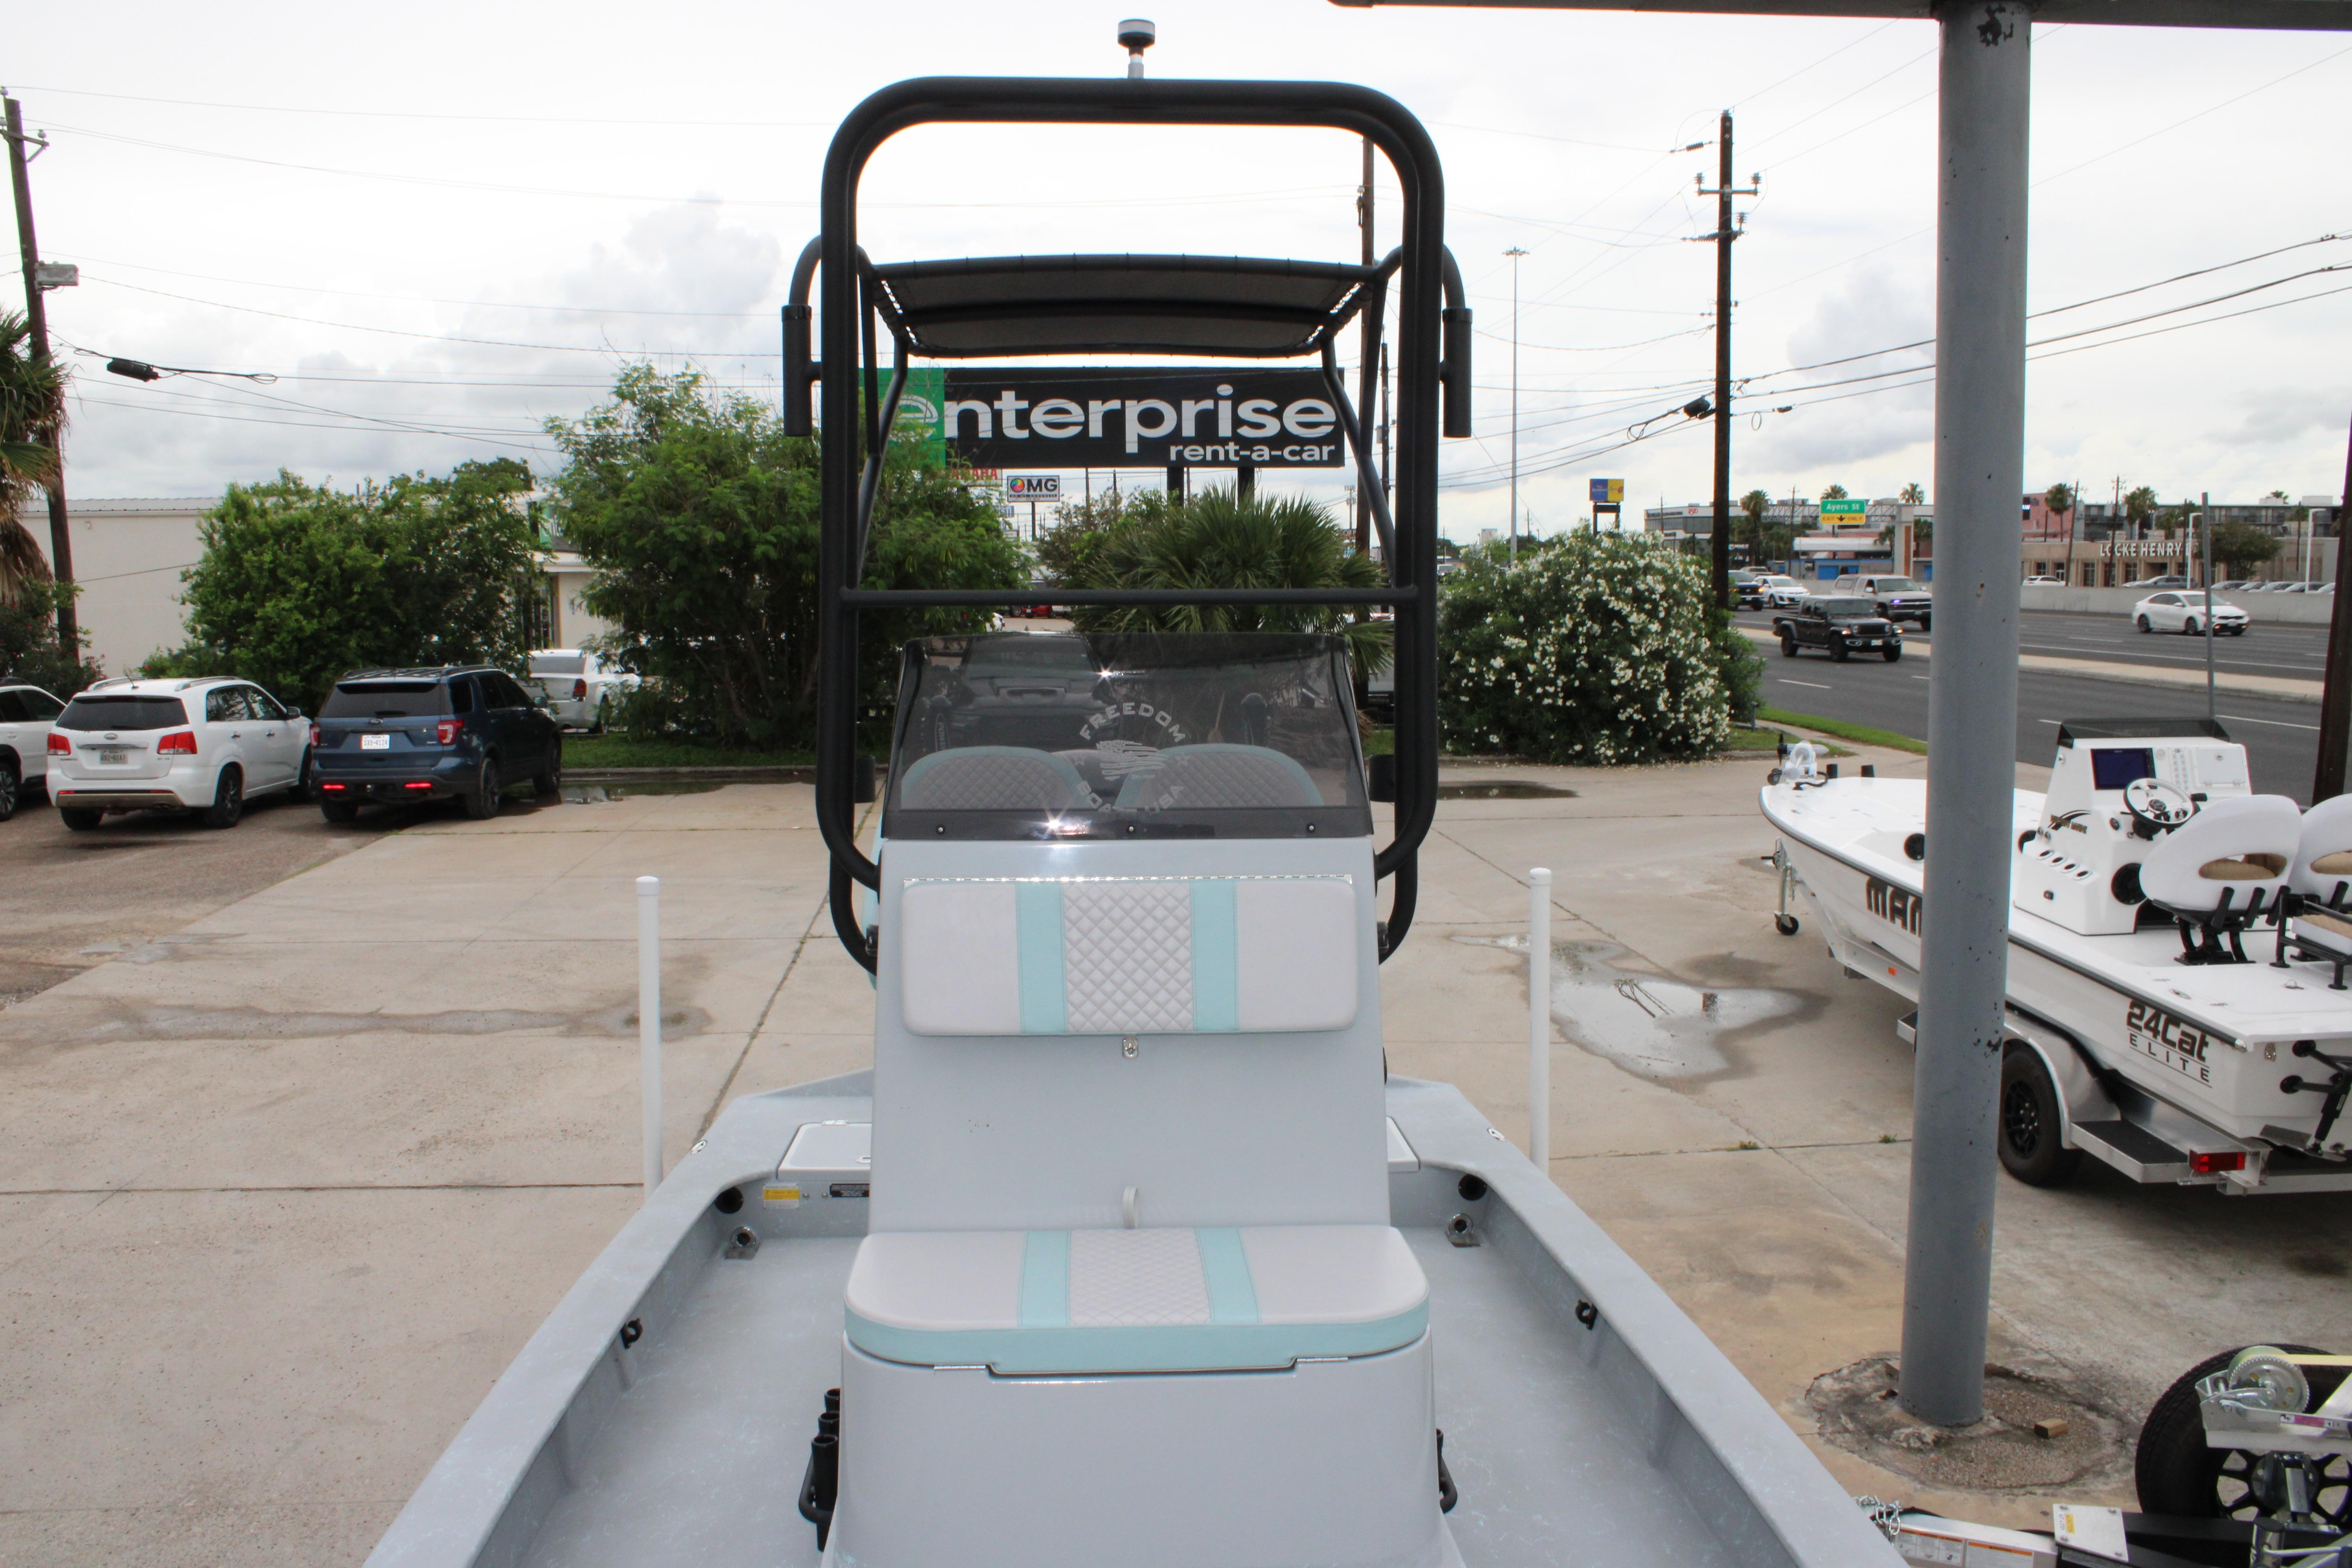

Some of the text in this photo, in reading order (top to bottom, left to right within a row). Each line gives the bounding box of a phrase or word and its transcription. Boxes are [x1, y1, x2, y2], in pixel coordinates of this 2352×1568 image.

[1170, 441, 1335, 461] rent-a-car
[1010, 478, 1058, 492] OMG
[2141, 542, 2182, 557] HENRY
[1080, 702, 1185, 743] FREEDOM
[2127, 999, 2209, 1063] 24Cat
[2130, 1033, 2209, 1083] ELITE
